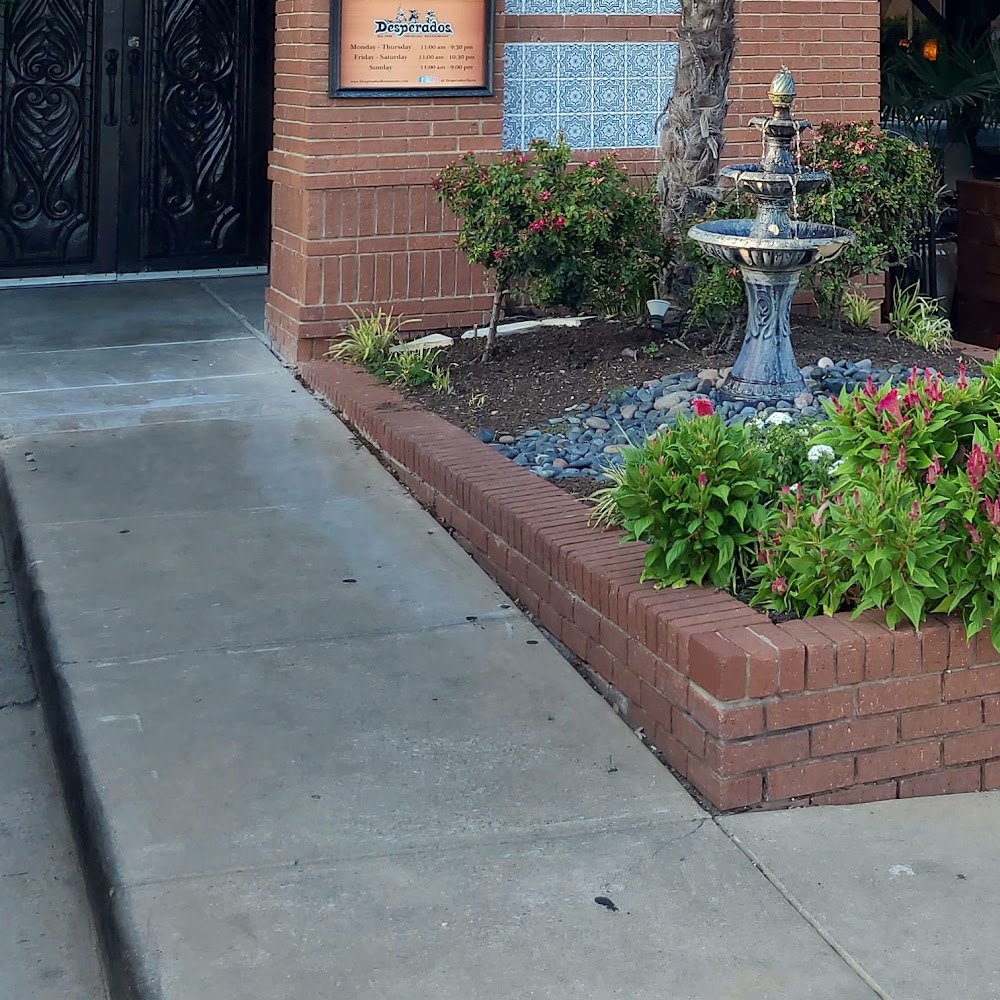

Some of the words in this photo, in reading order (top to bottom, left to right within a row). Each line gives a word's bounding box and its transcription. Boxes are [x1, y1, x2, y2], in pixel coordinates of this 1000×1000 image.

[375, 21, 453, 36] Desperados
[350, 43, 376, 51] Monday
[382, 43, 411, 51] Thursday
[354, 53, 374, 61] Friday
[379, 53, 407, 61] Saturday
